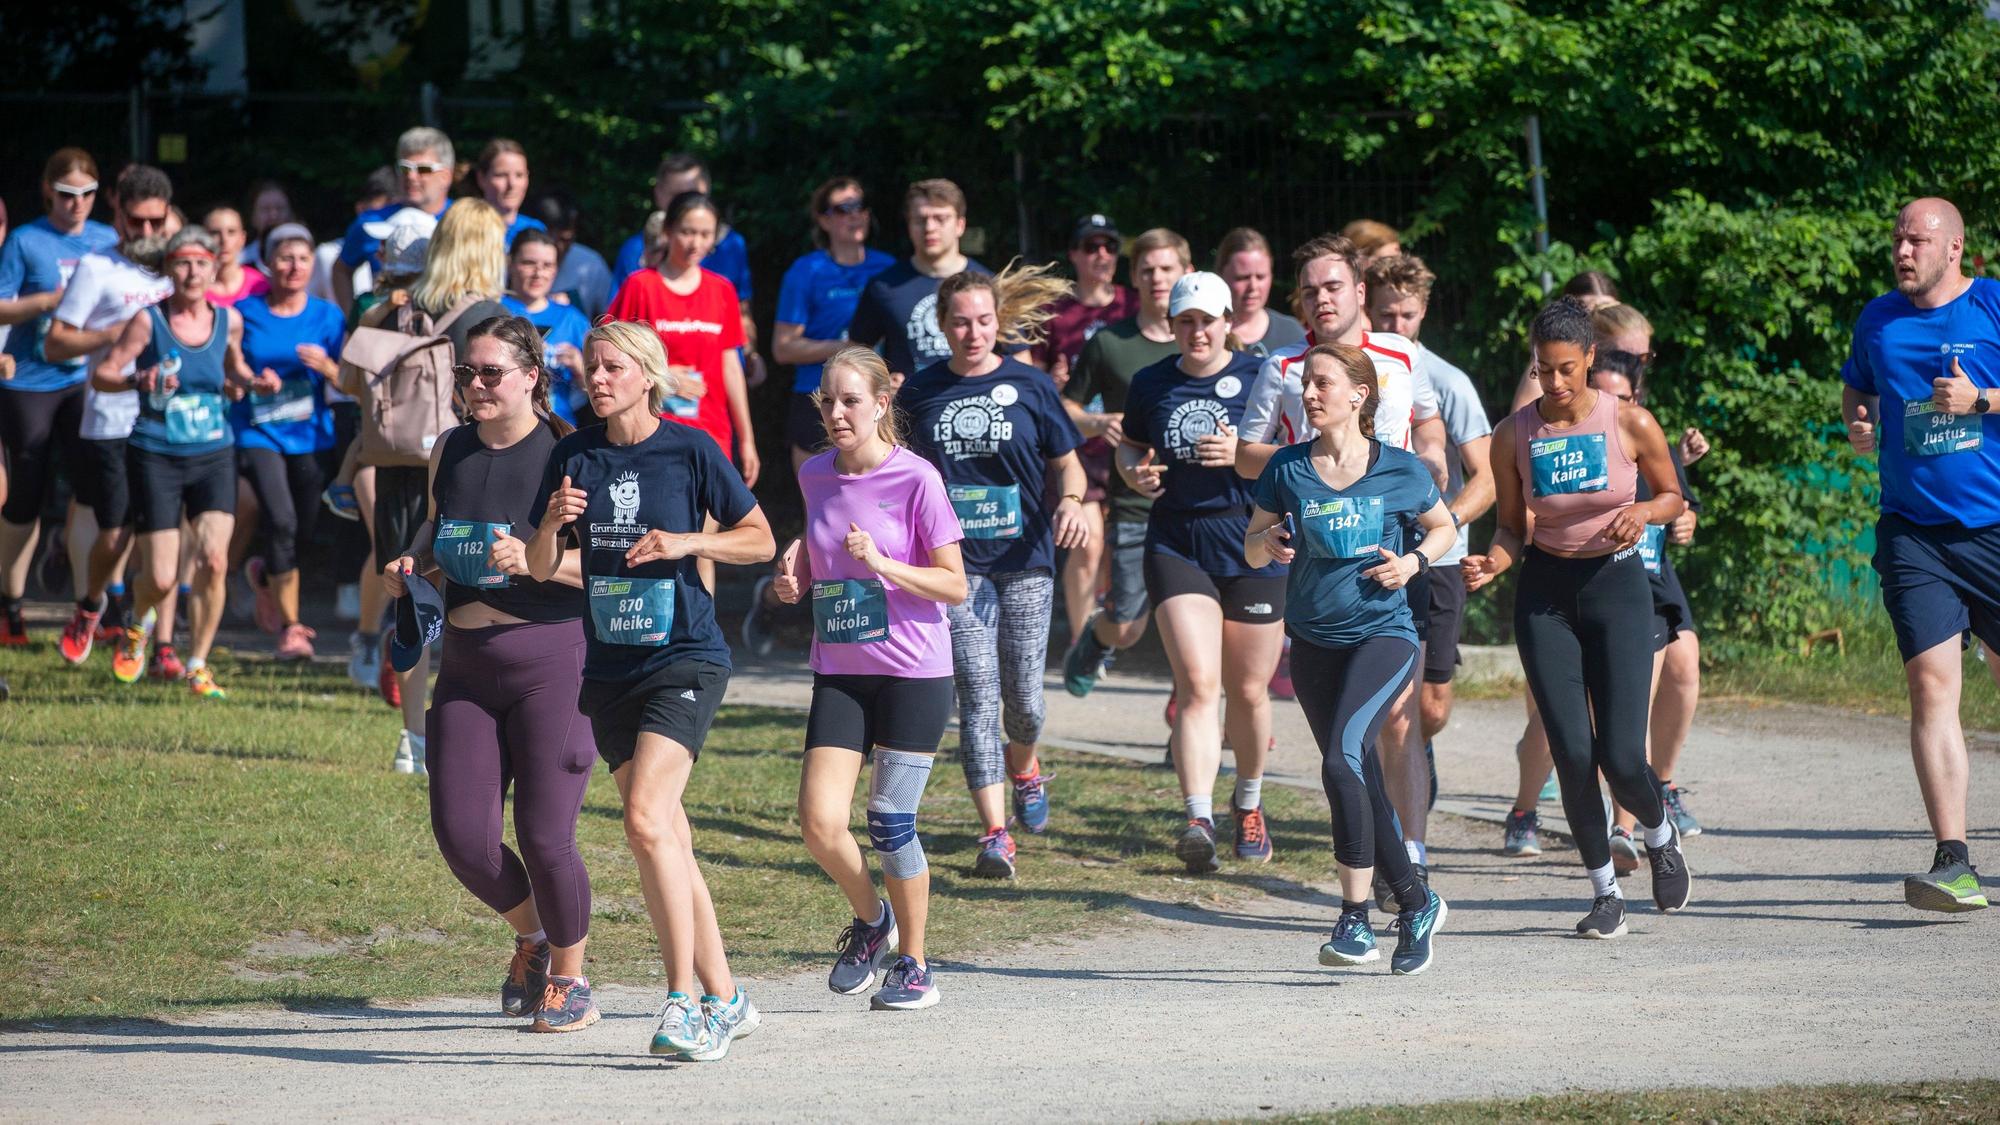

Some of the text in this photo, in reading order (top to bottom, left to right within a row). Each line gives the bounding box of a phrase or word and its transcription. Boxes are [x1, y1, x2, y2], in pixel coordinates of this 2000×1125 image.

[1931, 413, 1955, 428] 949
[933, 421, 1013, 442] 13 88
[1164, 428, 1182, 449] 13
[1922, 427, 1967, 446] Justus
[944, 438, 1000, 454] ZU KÖLN
[1553, 450, 1584, 468] 1123
[1551, 466, 1588, 485] Kaira
[975, 501, 998, 515] 765
[590, 522, 648, 534] Grundschule
[960, 510, 1016, 530] Annabell
[1327, 513, 1361, 531] 1347
[457, 541, 484, 556] 1182
[592, 537, 638, 549] Stenzelbe
[619, 597, 644, 613] 870
[834, 598, 856, 614] 671
[609, 614, 653, 632] Meike
[826, 612, 870, 633] Nicola
